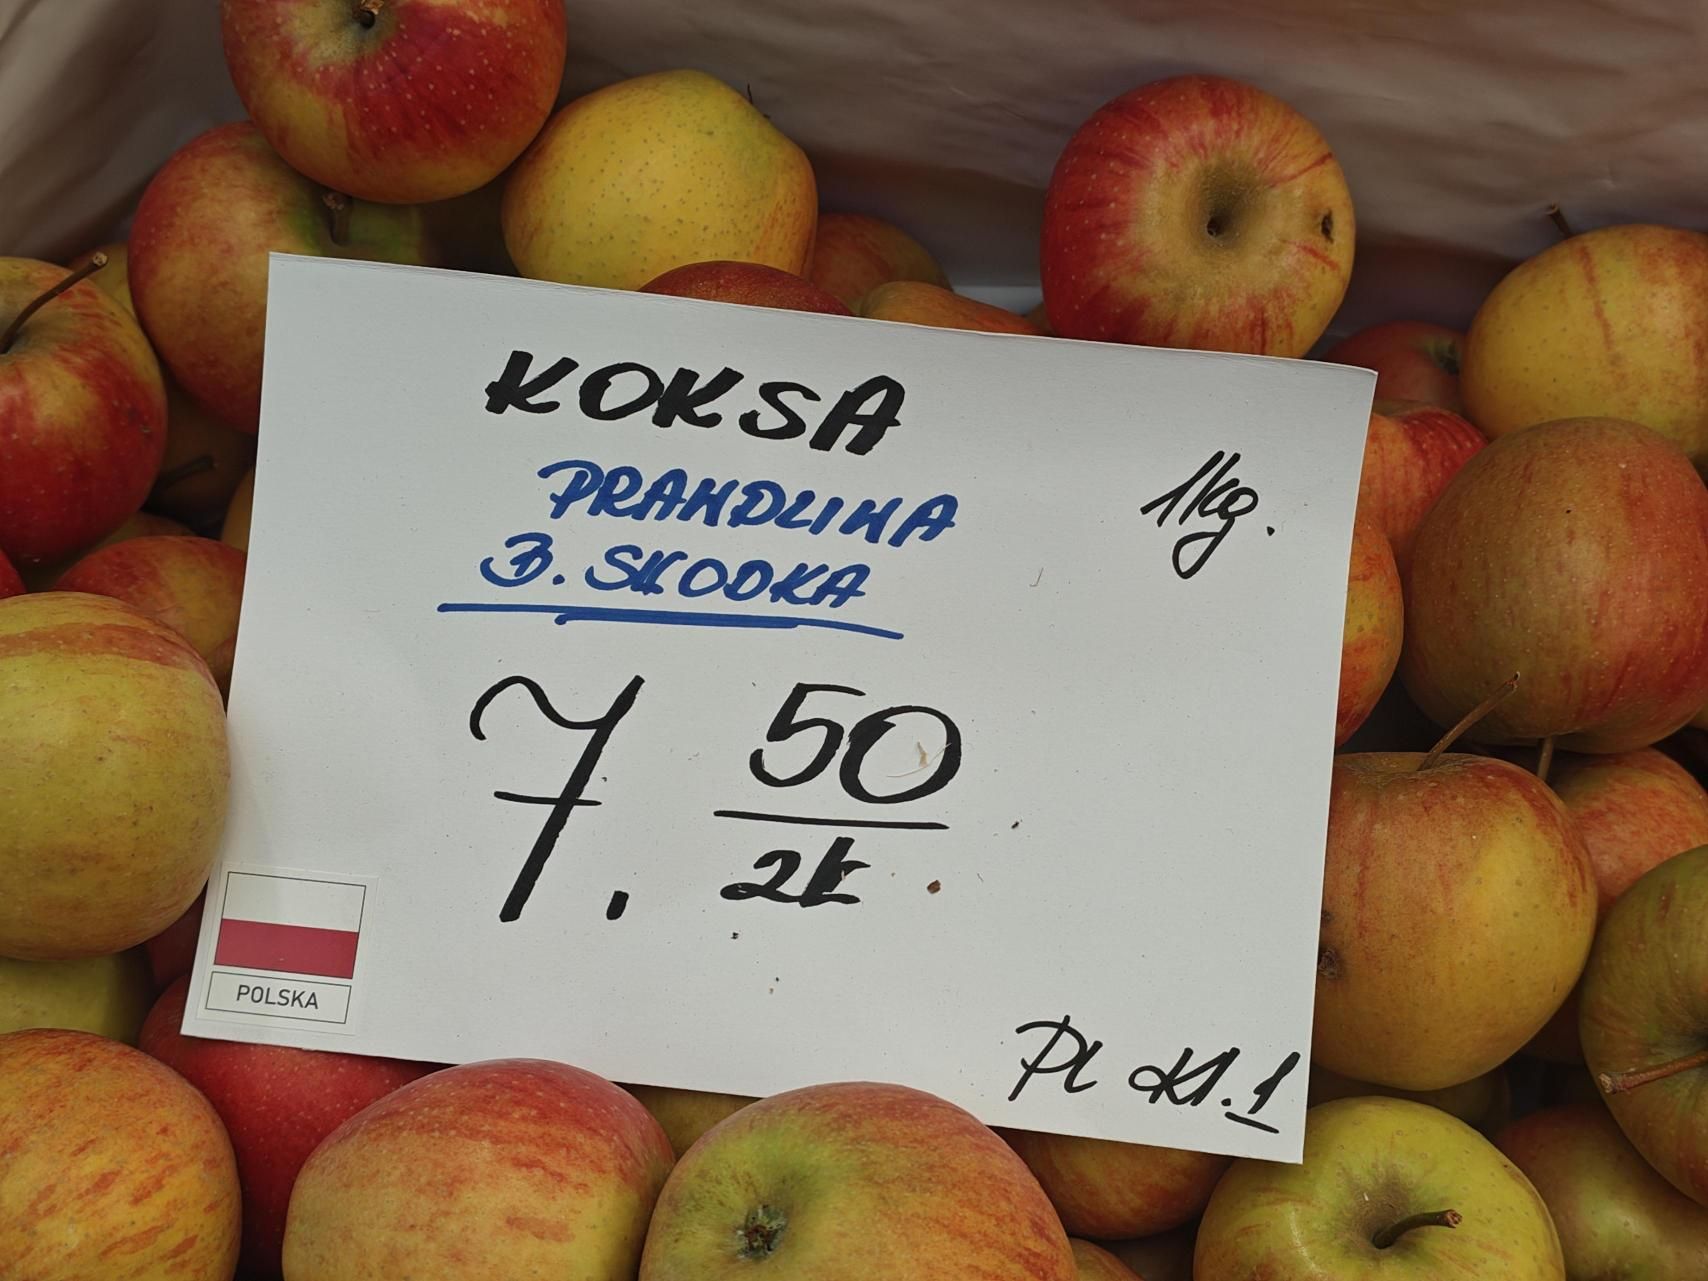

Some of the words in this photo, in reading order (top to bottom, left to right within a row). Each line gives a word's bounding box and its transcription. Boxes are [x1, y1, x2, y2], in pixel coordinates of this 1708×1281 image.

[484, 350, 906, 456] KOKSA
[749, 683, 962, 805] 50
[236, 984, 319, 1010] POLSKA
